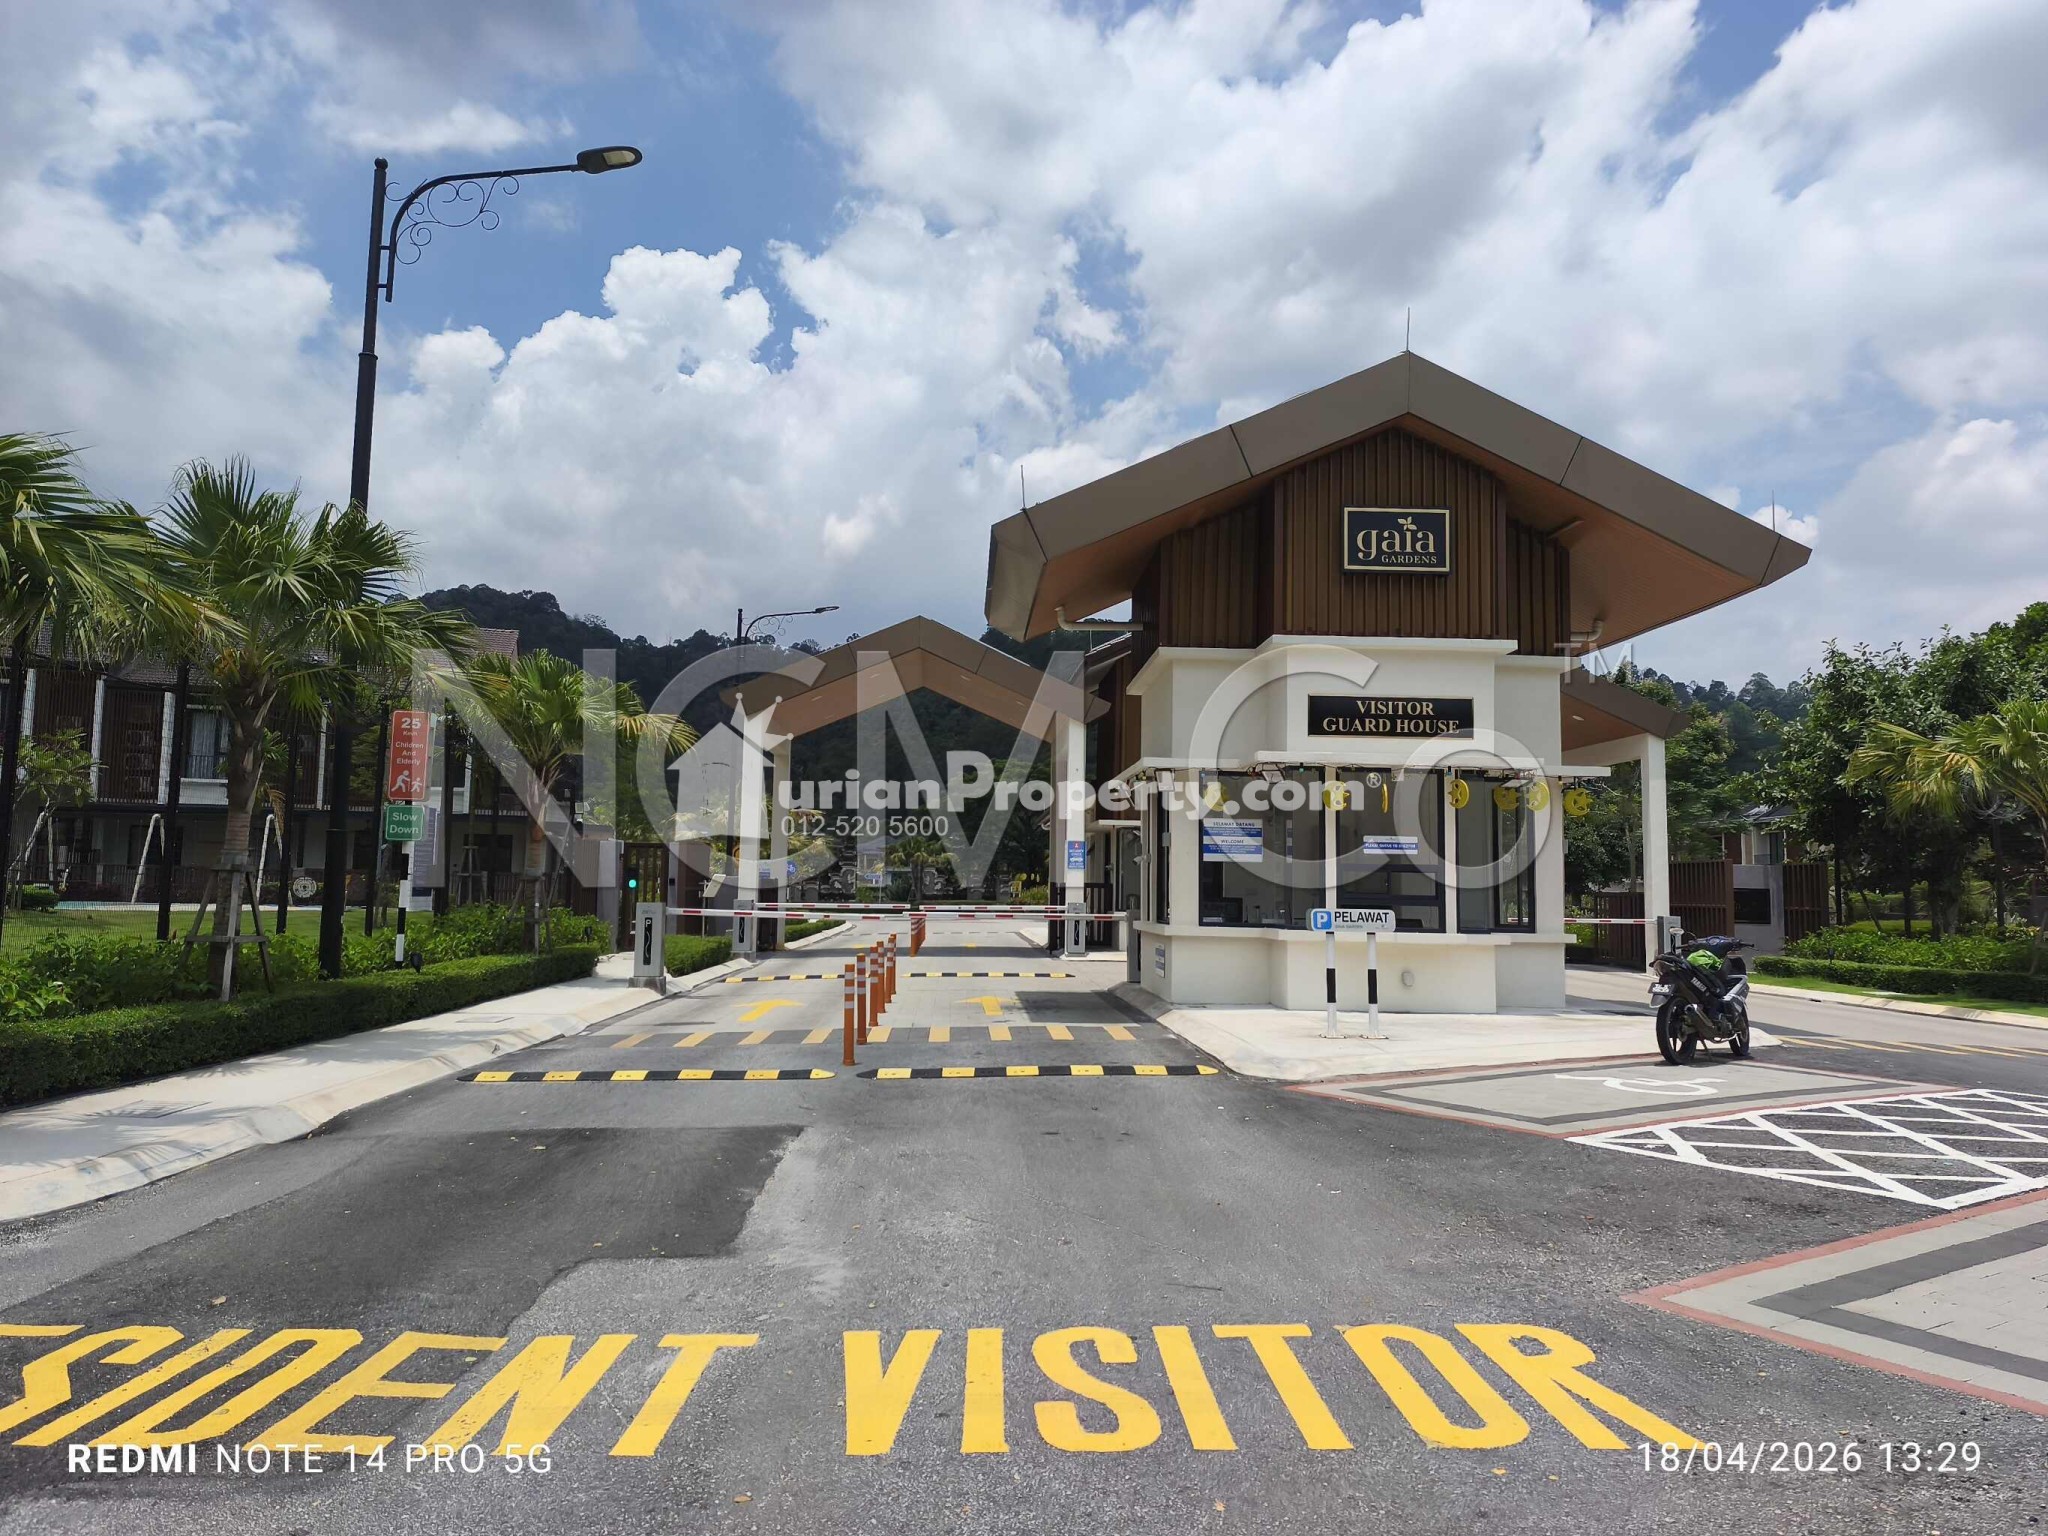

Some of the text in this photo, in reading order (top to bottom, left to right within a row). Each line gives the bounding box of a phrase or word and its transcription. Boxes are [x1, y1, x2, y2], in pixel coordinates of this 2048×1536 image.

[1356, 521, 1436, 560] gaia
[1381, 554, 1437, 564] GARDENS
[1356, 700, 1434, 716] VISITOR
[401, 717, 421, 729] 25
[1322, 717, 1460, 734] GUARD HOUSE
[395, 741, 424, 749] Children
[396, 758, 421, 766] Elderly
[392, 812, 418, 822] Slow
[389, 824, 419, 835] Down
[1316, 911, 1389, 928] P PELAWAT
[843, 1323, 1711, 1456] VISITOR
